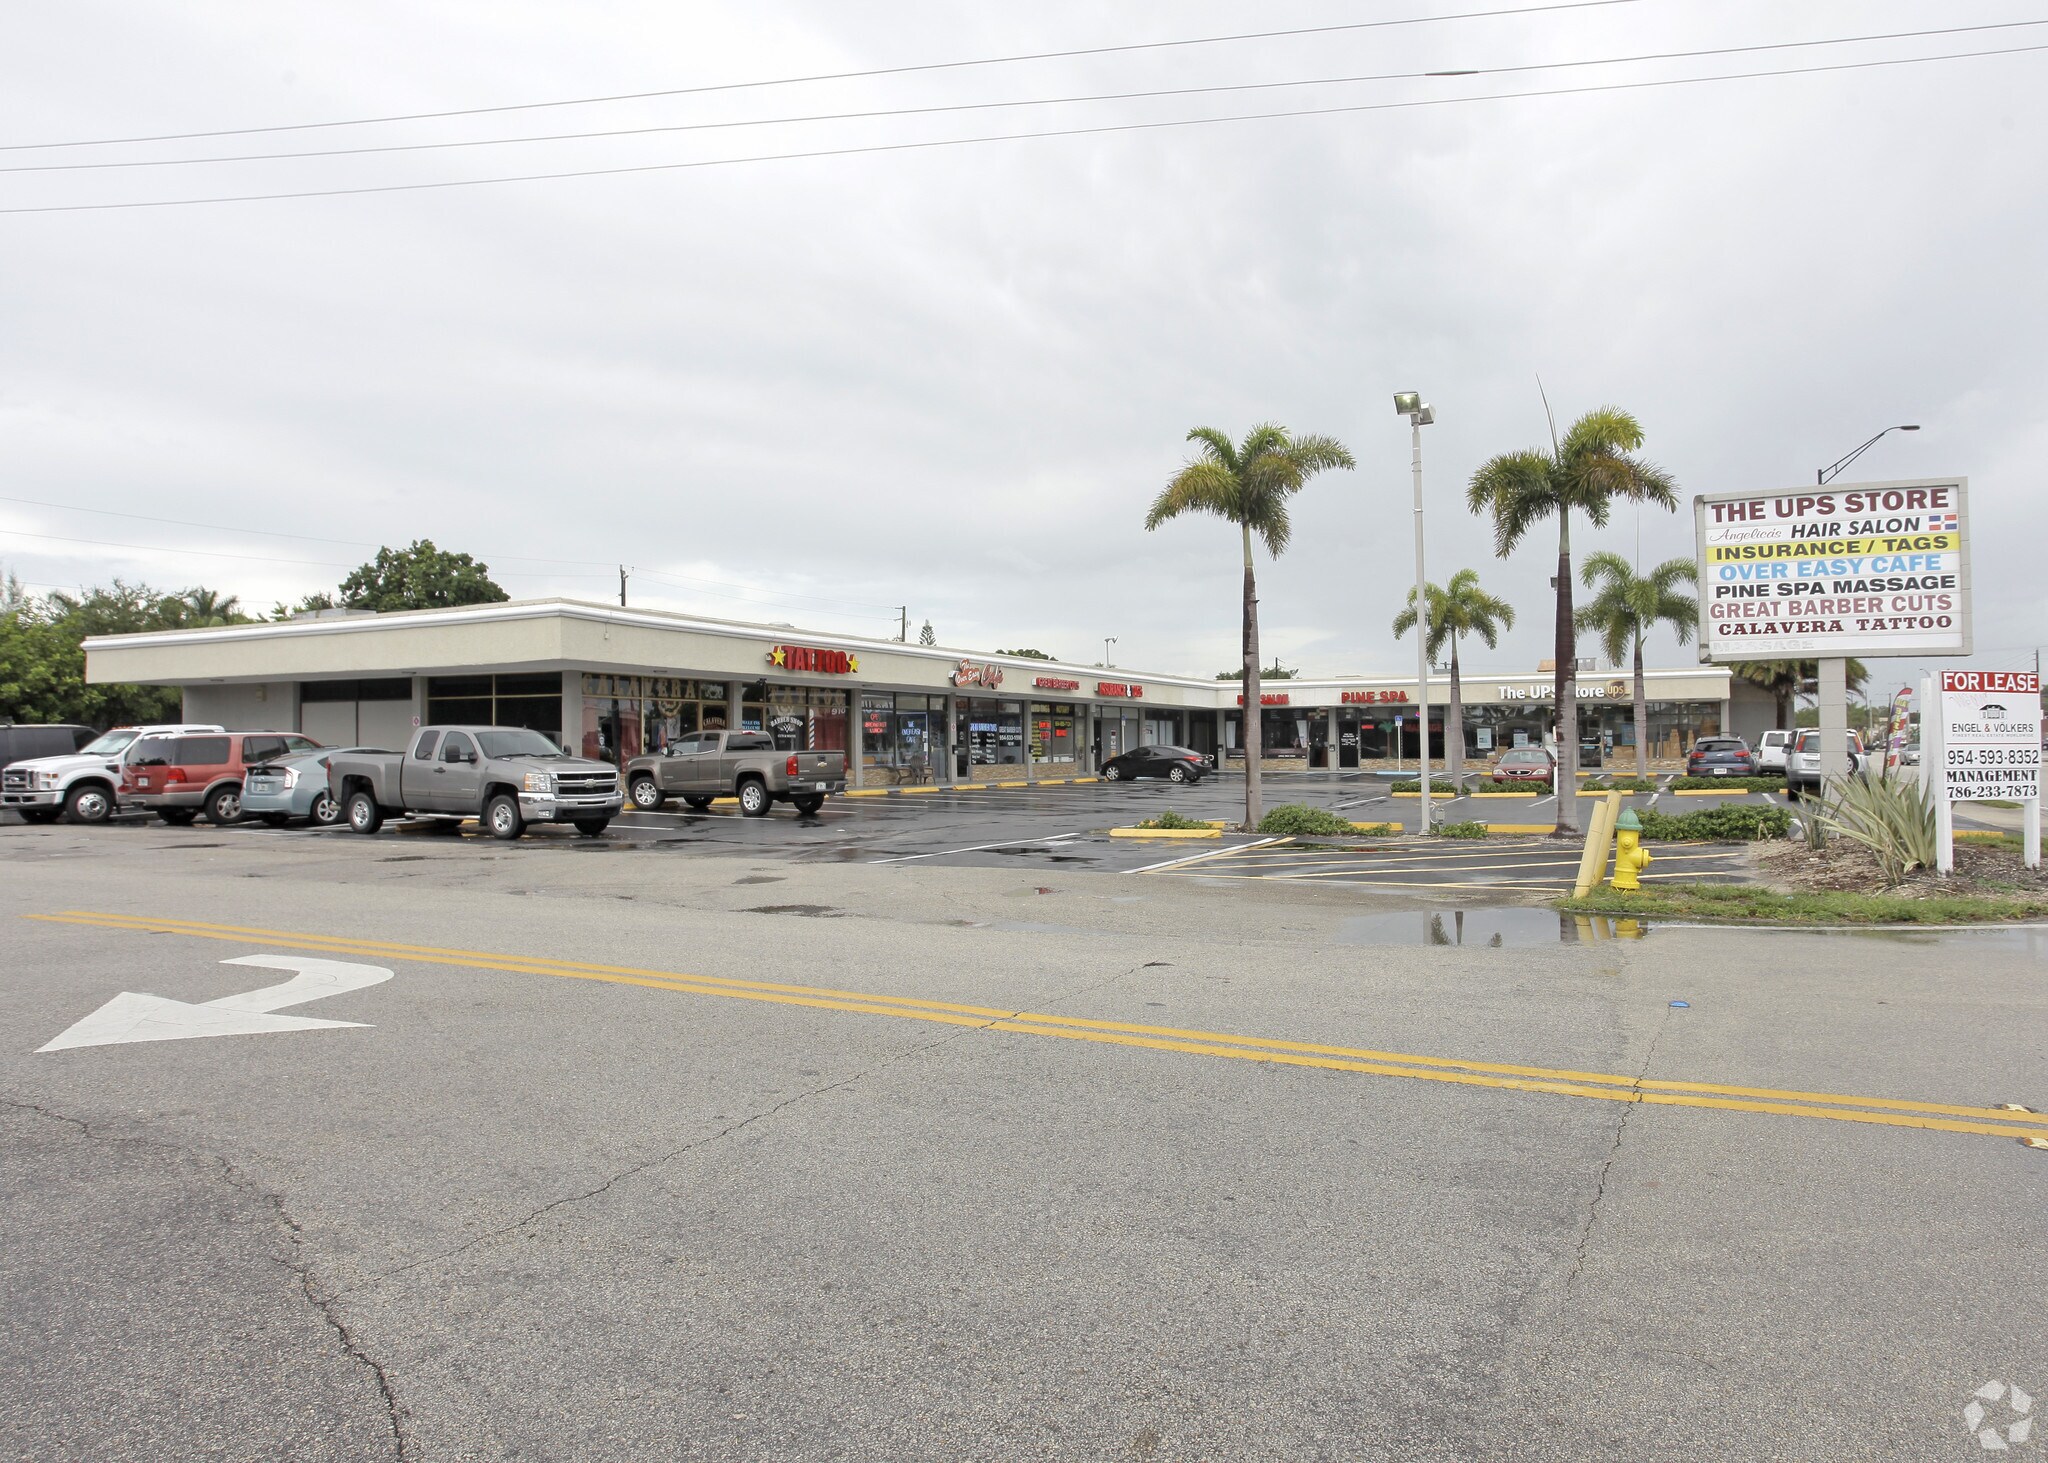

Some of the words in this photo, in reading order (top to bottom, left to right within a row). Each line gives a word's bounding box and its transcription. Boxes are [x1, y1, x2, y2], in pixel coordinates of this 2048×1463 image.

[1711, 501, 1766, 522] THE
[1775, 496, 1836, 518] UPS
[1844, 488, 1949, 513] STORE
[1791, 522, 1841, 539] HAIR
[1848, 517, 1920, 535] SALON
[1717, 540, 1861, 560] INSURANCE
[1882, 535, 1949, 552] TAGS
[1719, 563, 1788, 581] OVER
[1797, 558, 1868, 578] EASY
[1871, 554, 1941, 572] CAFE
[1716, 584, 1770, 599] PINE
[1777, 581, 1826, 597] SPA
[1833, 575, 1956, 594] MASSAGE
[1709, 601, 1781, 619] GREAT
[1788, 597, 1884, 616] BARBER
[1891, 594, 1953, 612] CUTS
[1718, 620, 1844, 636] CALAVERA
[1856, 615, 1952, 631] TATTOO
[782, 645, 847, 674] TATTOO
[583, 674, 696, 699] CALAVERA
[1038, 678, 1052, 689] GREAT
[1053, 679, 1069, 690] BARBER
[1070, 681, 1079, 691] CUTS
[1099, 682, 1126, 697] INSURANCE
[1607, 684, 1624, 696] ups
[1943, 672, 1980, 690] FOR
[1984, 673, 2038, 692] LEASE
[768, 686, 846, 705] TATTOO
[1260, 694, 1289, 705] SALON
[1341, 692, 1375, 704] PINE
[1380, 691, 1408, 703] SPA
[1498, 686, 1526, 699] The
[1576, 686, 1605, 698] tore
[1952, 723, 1982, 733] ENGEL
[1984, 723, 1990, 733] &
[1946, 770, 2037, 782] MANAGEMENT
[1946, 785, 2037, 798] 786-233-7873
